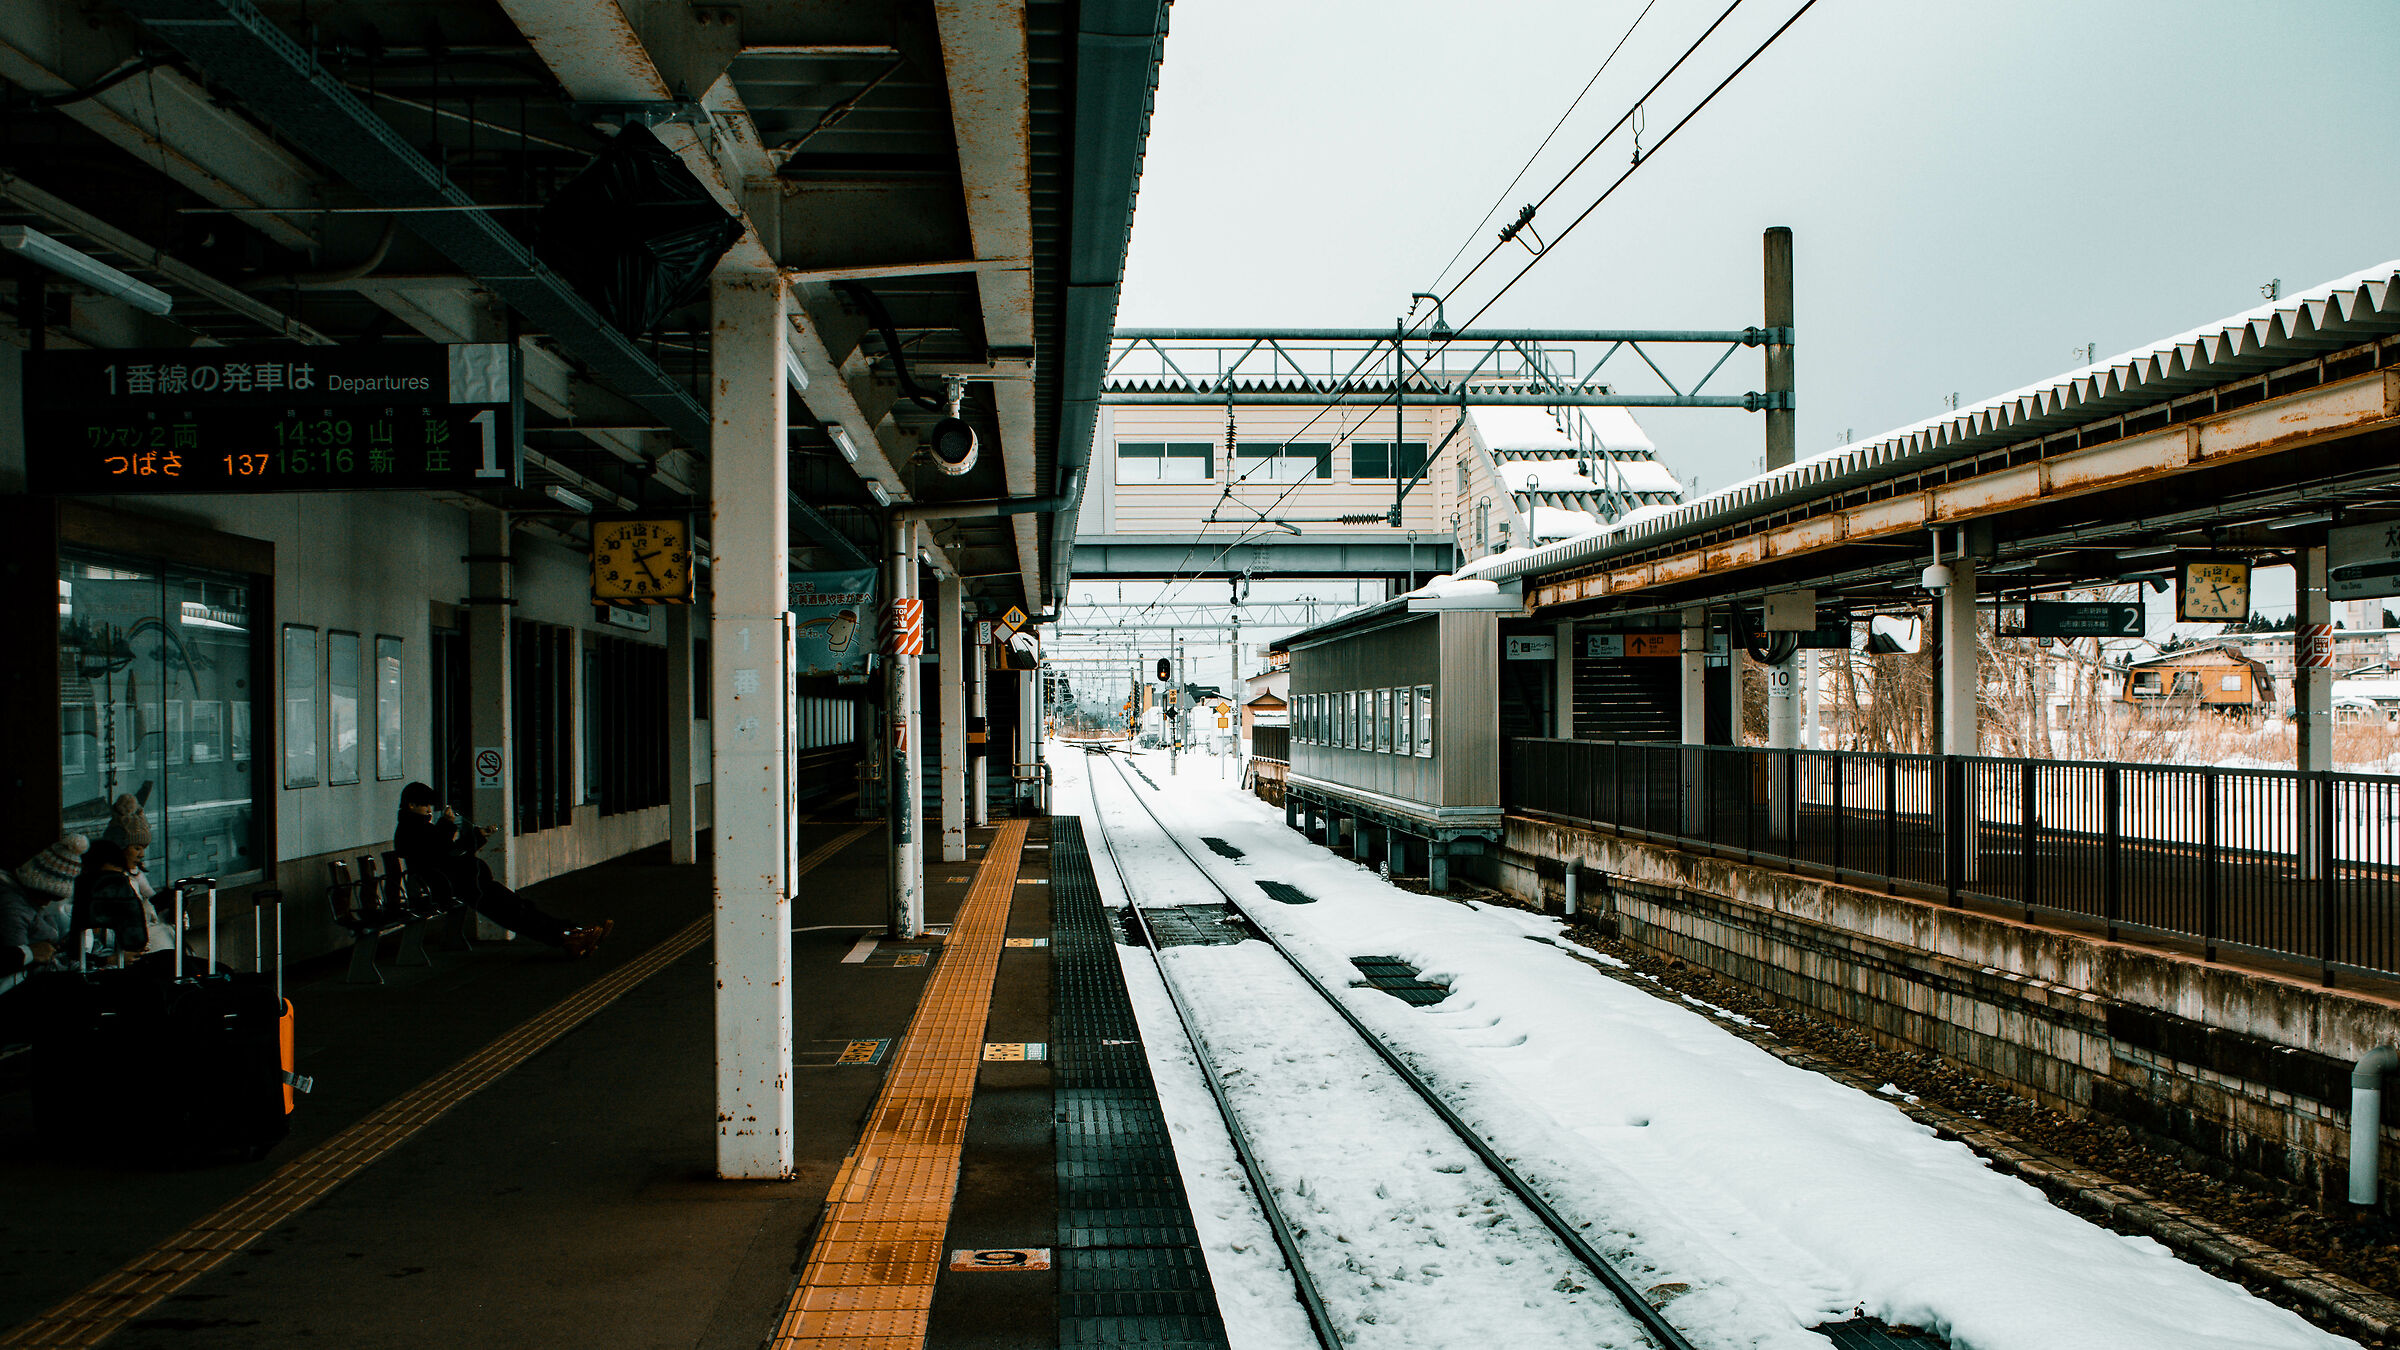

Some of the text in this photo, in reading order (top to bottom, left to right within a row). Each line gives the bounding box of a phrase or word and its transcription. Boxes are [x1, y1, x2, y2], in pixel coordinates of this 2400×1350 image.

[104, 362, 430, 395] 1番線の発車は Departures
[274, 420, 353, 445] 14:39
[469, 410, 506, 478] 1
[104, 451, 183, 477] つばさ
[223, 453, 270, 476] 137
[276, 448, 354, 474] 15:16
[620, 530, 631, 540] 11
[633, 527, 647, 536] 12
[608, 540, 621, 550] 10
[632, 538, 647, 548] JR
[664, 537, 673, 546] 2
[601, 555, 610, 565] 9
[672, 553, 681, 563] 3
[610, 571, 618, 580] 8
[664, 569, 674, 578] 4
[623, 580, 632, 589] 7
[2231, 576, 2239, 584] 2
[637, 581, 647, 591] 6
[1009, 612, 1020, 623] 山
[2122, 607, 2140, 632] 2
[981, 622, 989, 643] ワンマン
[926, 627, 935, 649] 1
[1771, 671, 1789, 686] 10
[896, 727, 906, 749] 7
